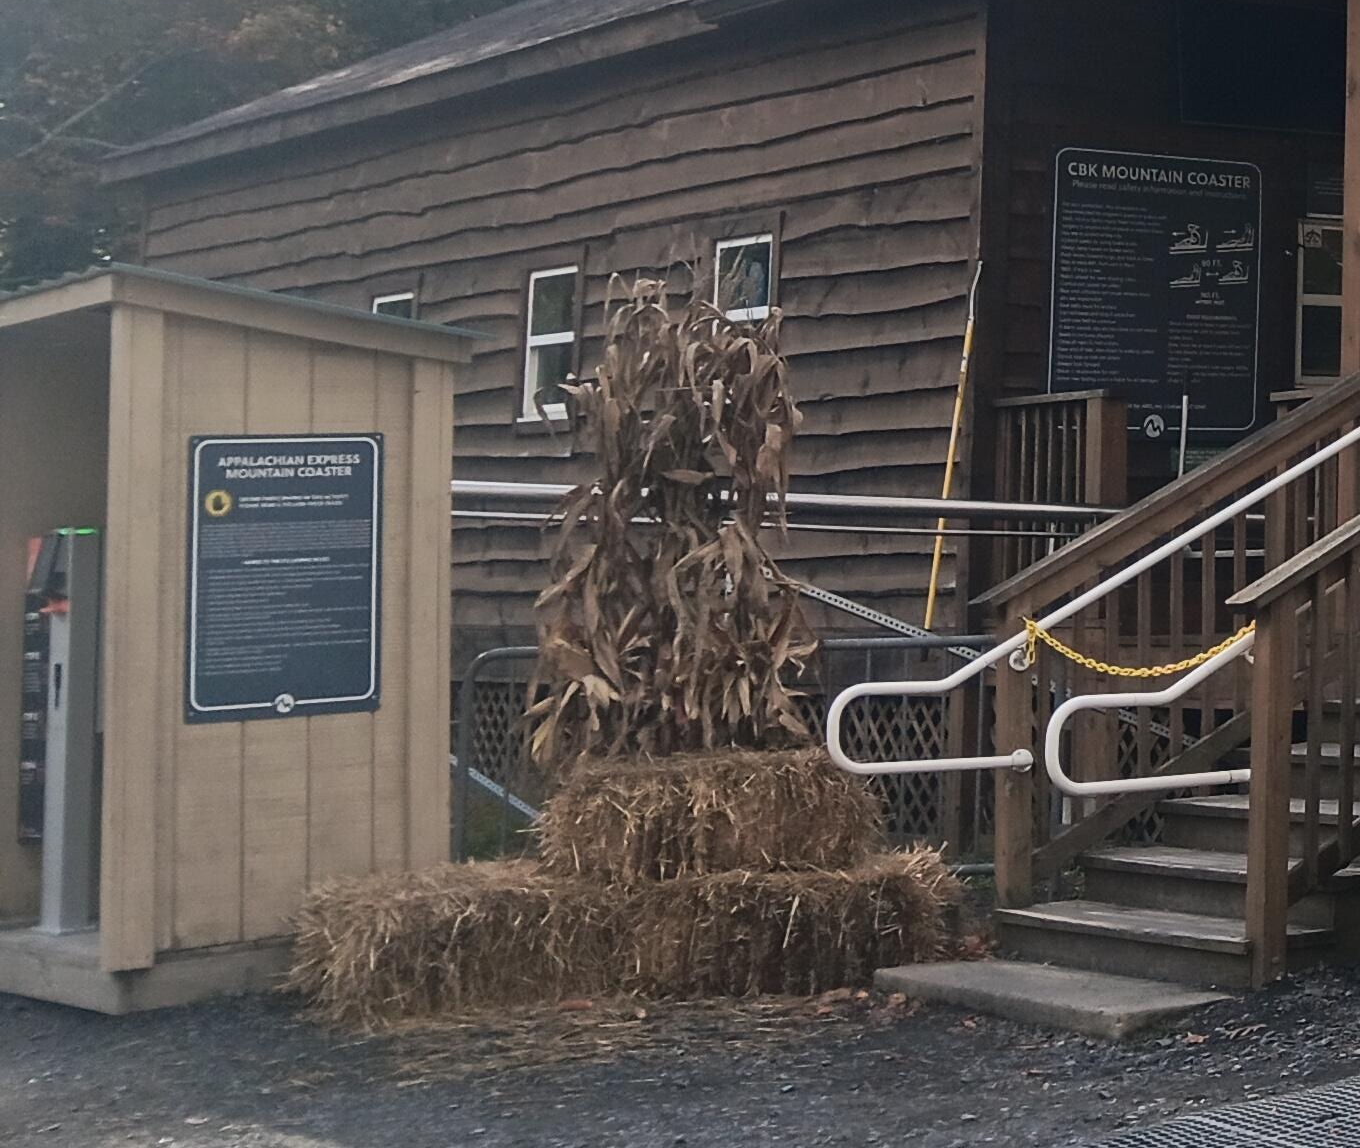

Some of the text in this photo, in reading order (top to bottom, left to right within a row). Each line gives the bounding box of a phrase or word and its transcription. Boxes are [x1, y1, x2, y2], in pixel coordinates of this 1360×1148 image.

[1067, 162, 1251, 189] CBK MOUNTAIN COASTER
[1072, 179, 1097, 189] Please
[1099, 181, 1117, 190] read
[1119, 182, 1141, 193] safety
[217, 453, 360, 467] APPALACHIAN EXPRESS
[225, 466, 353, 479] MOUNTAIN COASTER
